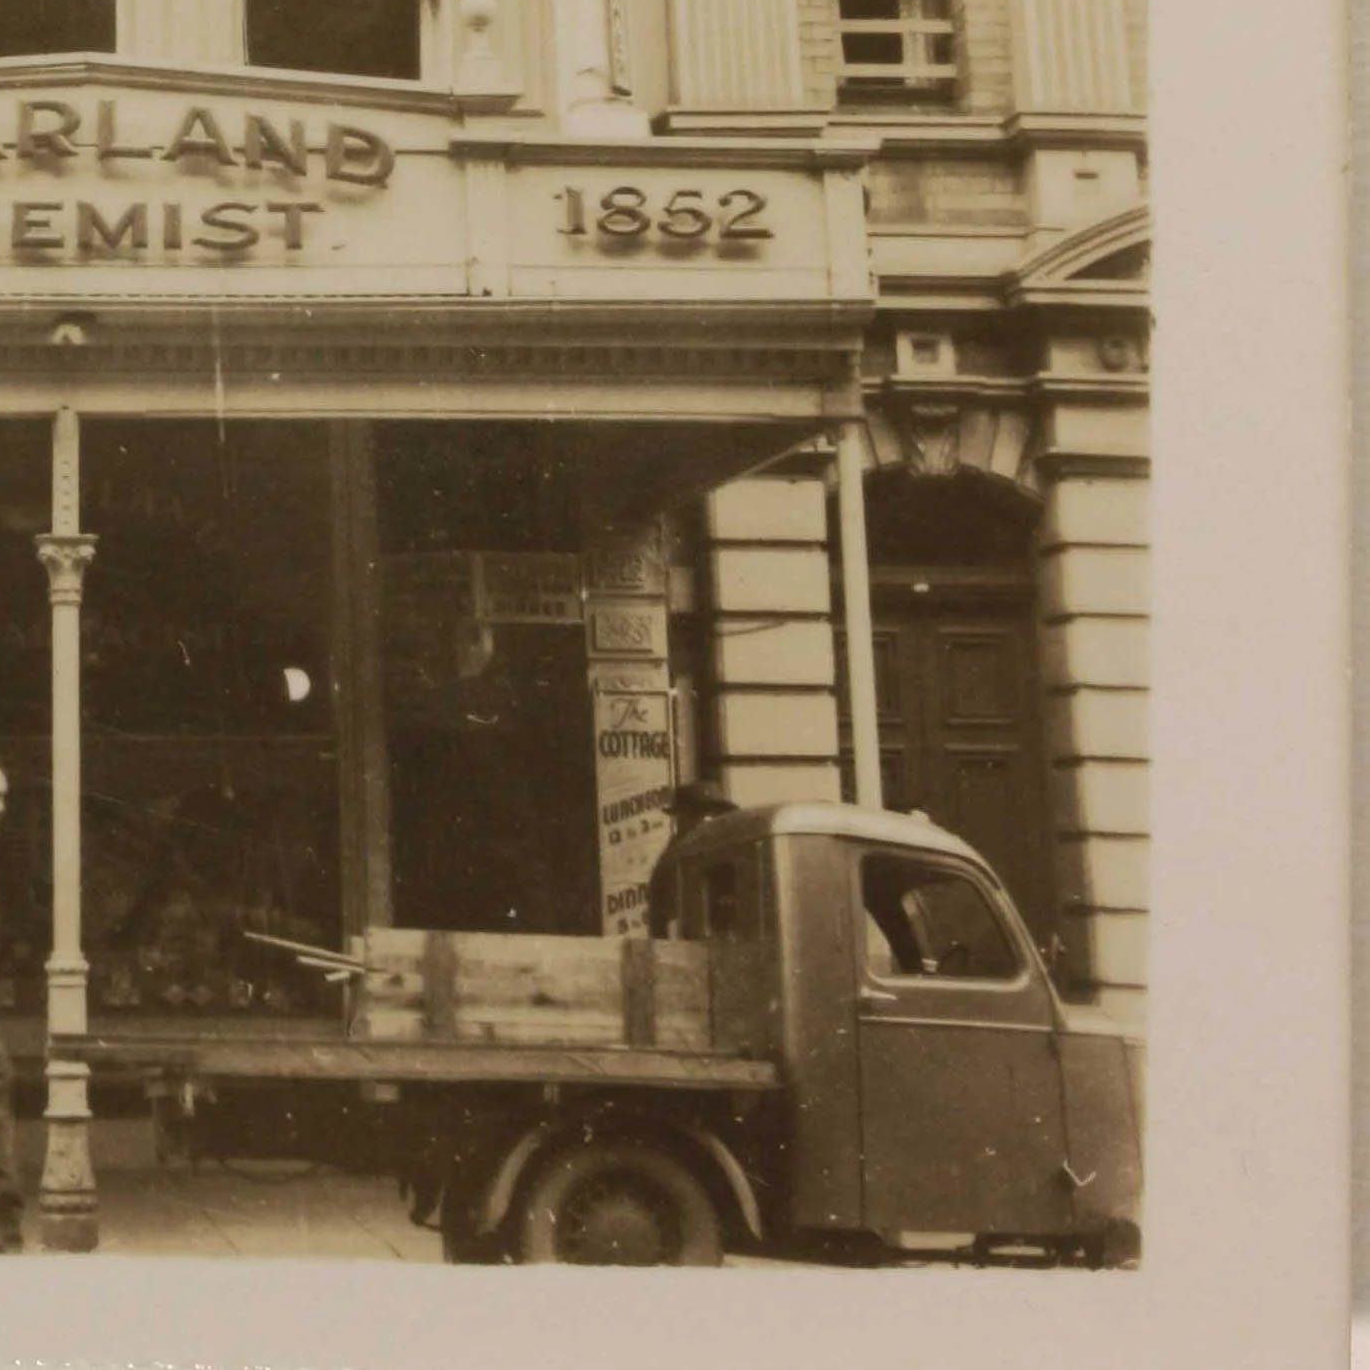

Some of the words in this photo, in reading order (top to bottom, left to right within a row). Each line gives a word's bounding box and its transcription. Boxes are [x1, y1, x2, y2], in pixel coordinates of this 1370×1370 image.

[554, 184, 775, 243] 1852
[609, 697, 649, 729] The
[599, 730, 670, 759] COTTAGE
